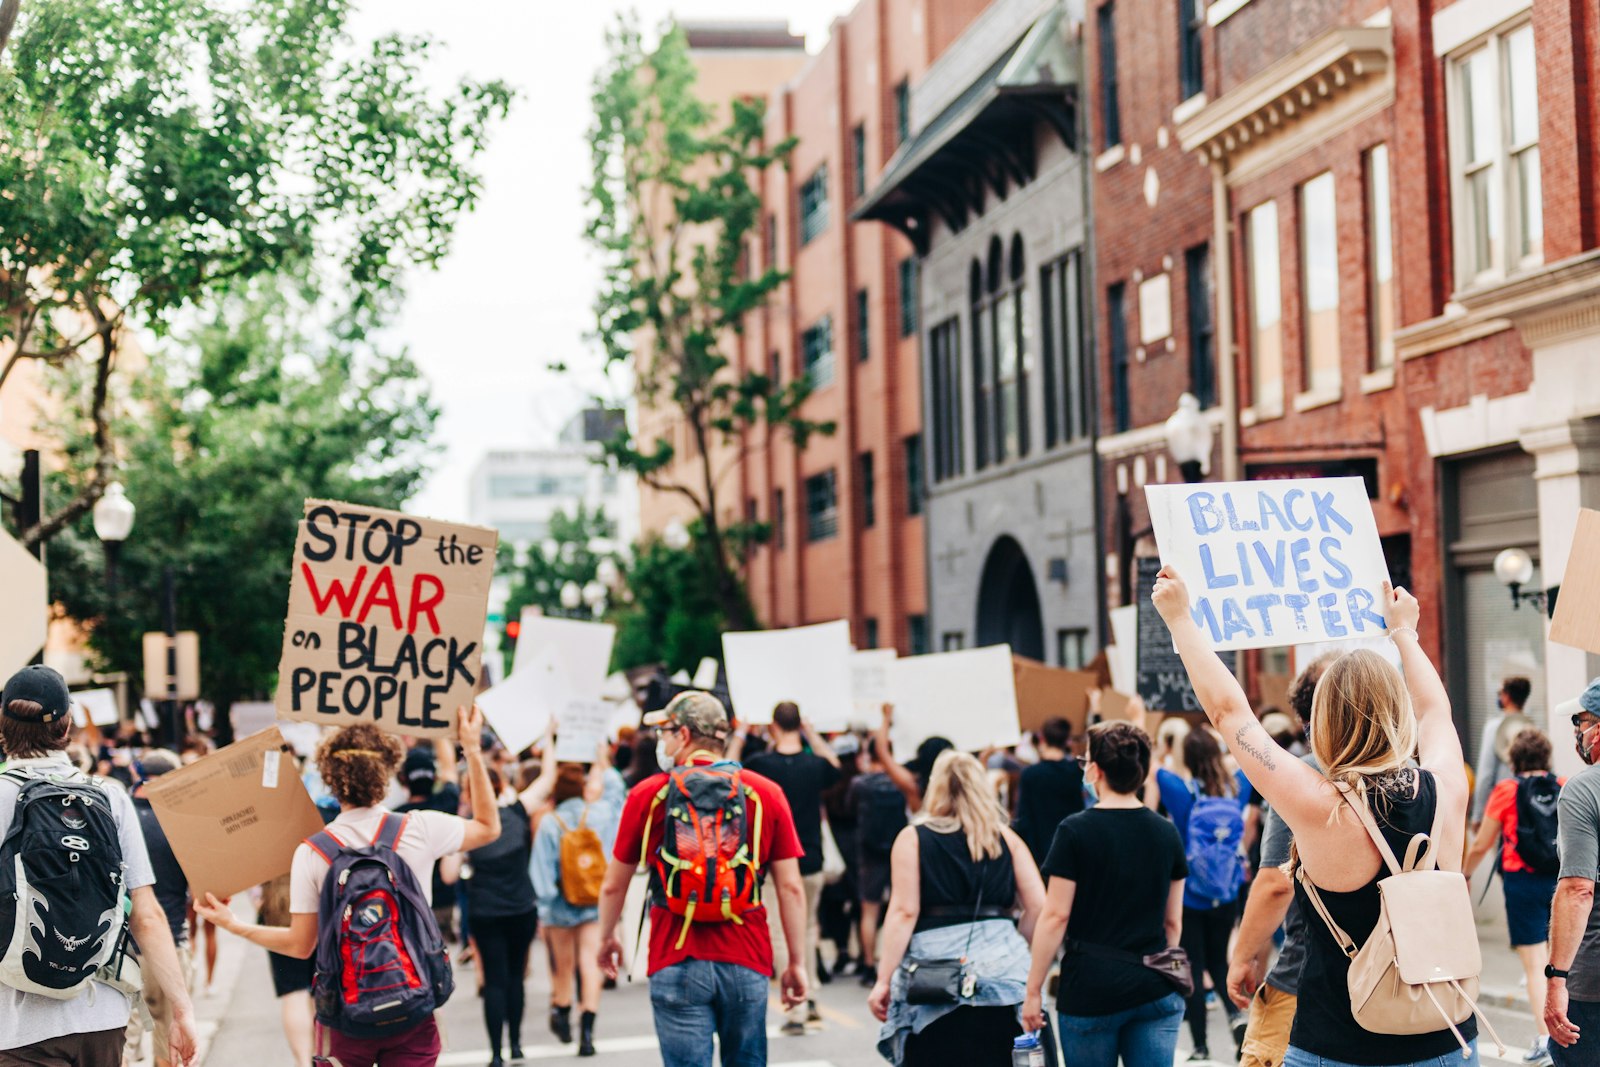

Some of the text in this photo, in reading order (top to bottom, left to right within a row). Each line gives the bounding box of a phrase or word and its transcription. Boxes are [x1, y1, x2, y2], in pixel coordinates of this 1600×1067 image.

[303, 506, 484, 565] STOP the
[1185, 488, 1353, 535] BLACK
[1199, 537, 1353, 593] LIVES
[301, 562, 445, 635] WAR
[1189, 588, 1388, 643] MATTER
[292, 621, 477, 687] on BLACK
[292, 667, 449, 728] PEOPLE
